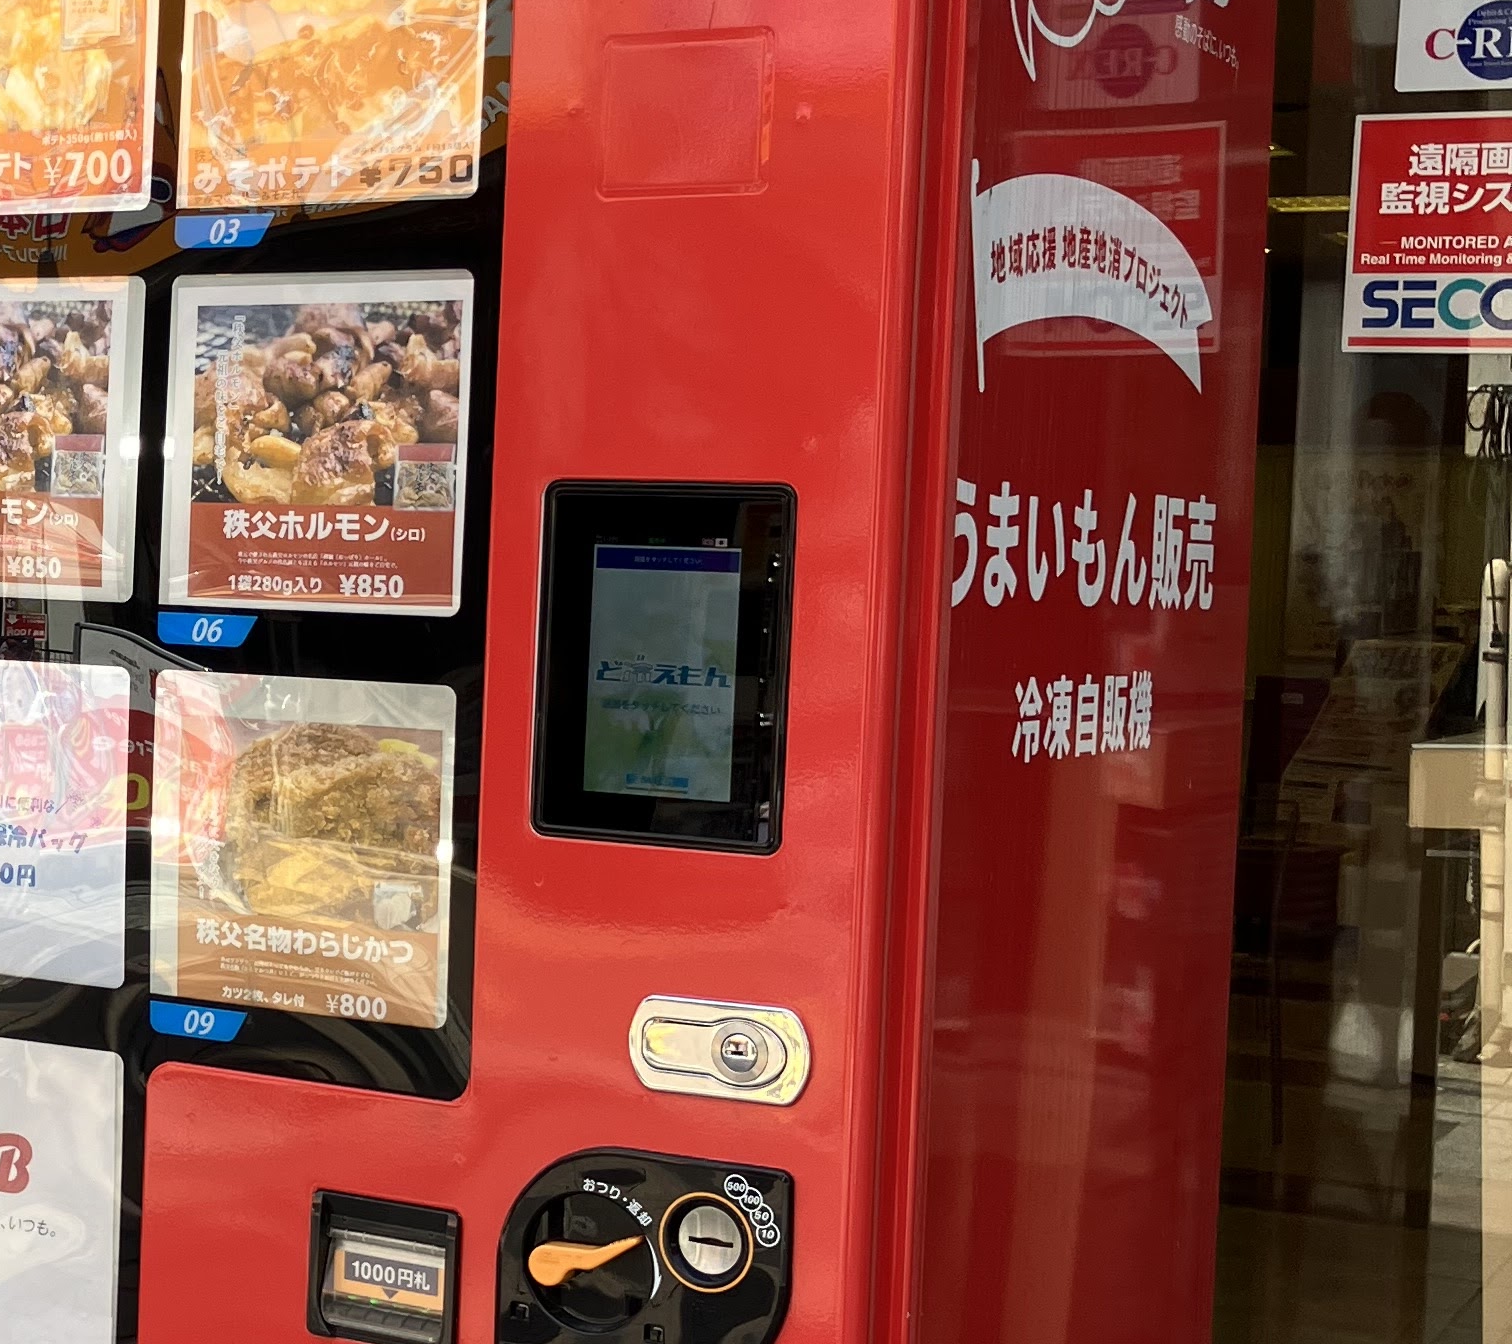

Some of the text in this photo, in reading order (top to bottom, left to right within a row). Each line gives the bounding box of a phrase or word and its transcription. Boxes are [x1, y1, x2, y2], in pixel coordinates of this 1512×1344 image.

[44, 148, 133, 187] ¥700
[192, 155, 473, 195] みそポテト ¥750
[209, 219, 240, 245] 03
[1401, 236, 1499, 250] MONITORED
[1361, 252, 1505, 267] Real Time Monitoring
[990, 226, 1189, 331] 地域応援 地産地消プロジェクト
[223, 509, 390, 542] 秩父ホルモン
[951, 477, 1217, 611] うまいもん販売
[7, 555, 62, 579] ¥850
[228, 574, 404, 598] 1袋280g入り ¥850
[192, 618, 223, 643] 06
[1012, 670, 1154, 763] 冷凍自販機
[196, 917, 414, 965] 秩父名物わらじかつ
[221, 985, 387, 1021] カツ2枚、タレ付 ¥800
[184, 1009, 215, 1035] 09
[726, 1180, 747, 1194] 500
[742, 1193, 760, 1207] 100
[582, 1177, 654, 1227] おつり・返却
[754, 1209, 770, 1222] 50
[760, 1228, 776, 1241] 10
[352, 1259, 430, 1291] 1000円札
